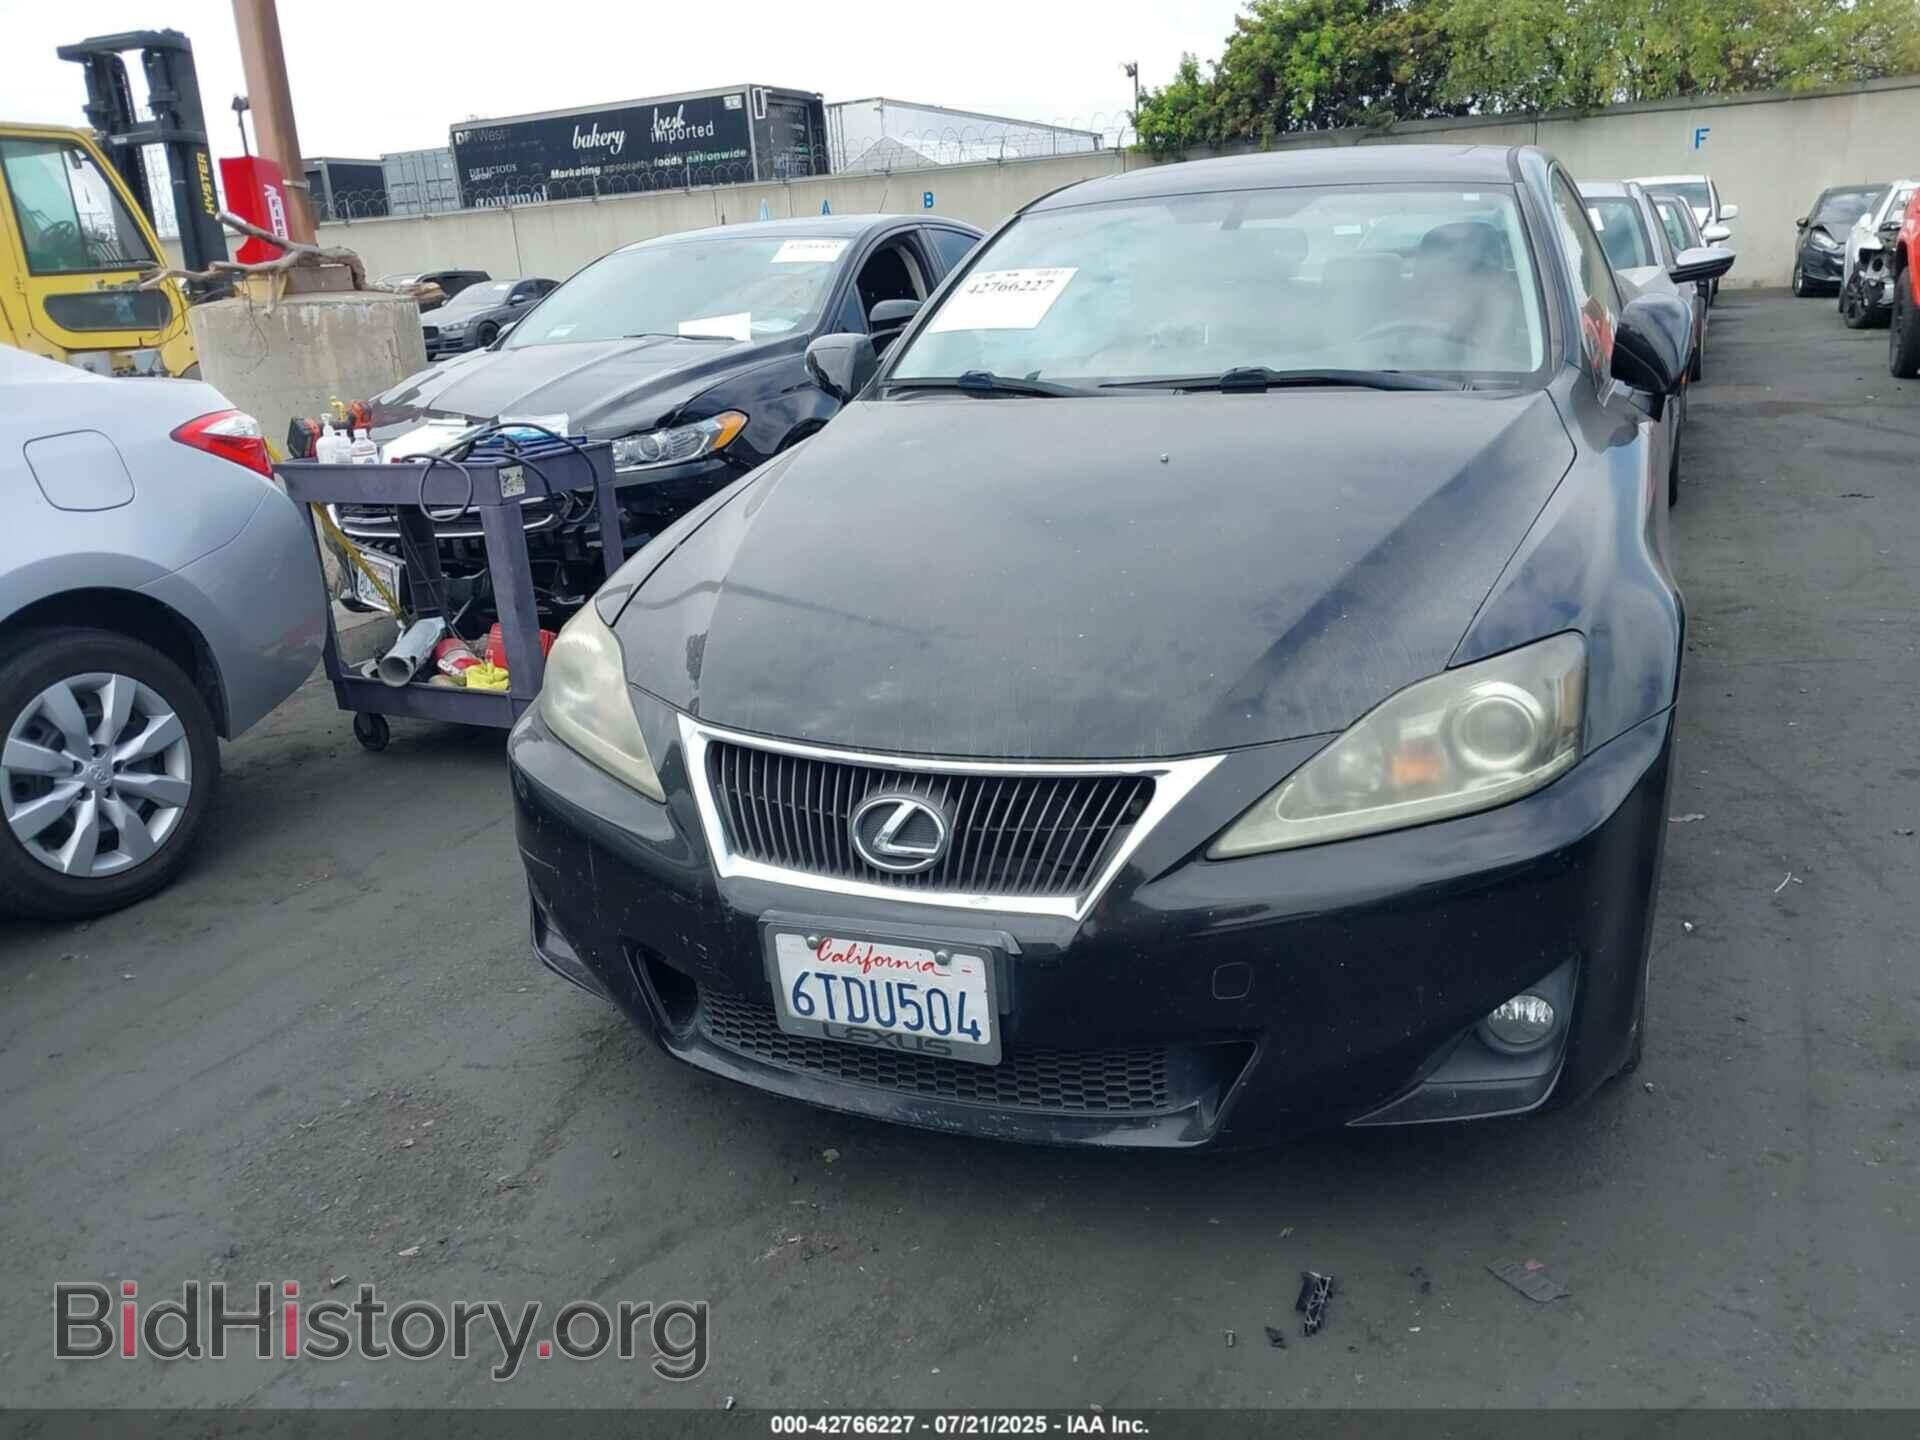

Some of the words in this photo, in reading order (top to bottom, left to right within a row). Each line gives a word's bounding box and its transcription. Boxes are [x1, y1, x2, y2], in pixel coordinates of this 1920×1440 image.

[572, 122, 626, 155] bakery
[650, 120, 715, 145] imported
[1695, 128, 1710, 150] F
[550, 165, 601, 180] Marketing
[654, 155, 683, 168] foods
[685, 148, 748, 164] nationwide
[197, 152, 216, 216] HYSTER
[923, 191, 934, 209] B
[270, 198, 286, 238] FIRE
[821, 199, 831, 215] A
[816, 937, 952, 976] California
[791, 971, 982, 1042] 6TDU504
[823, 1020, 953, 1056] LEXUS
